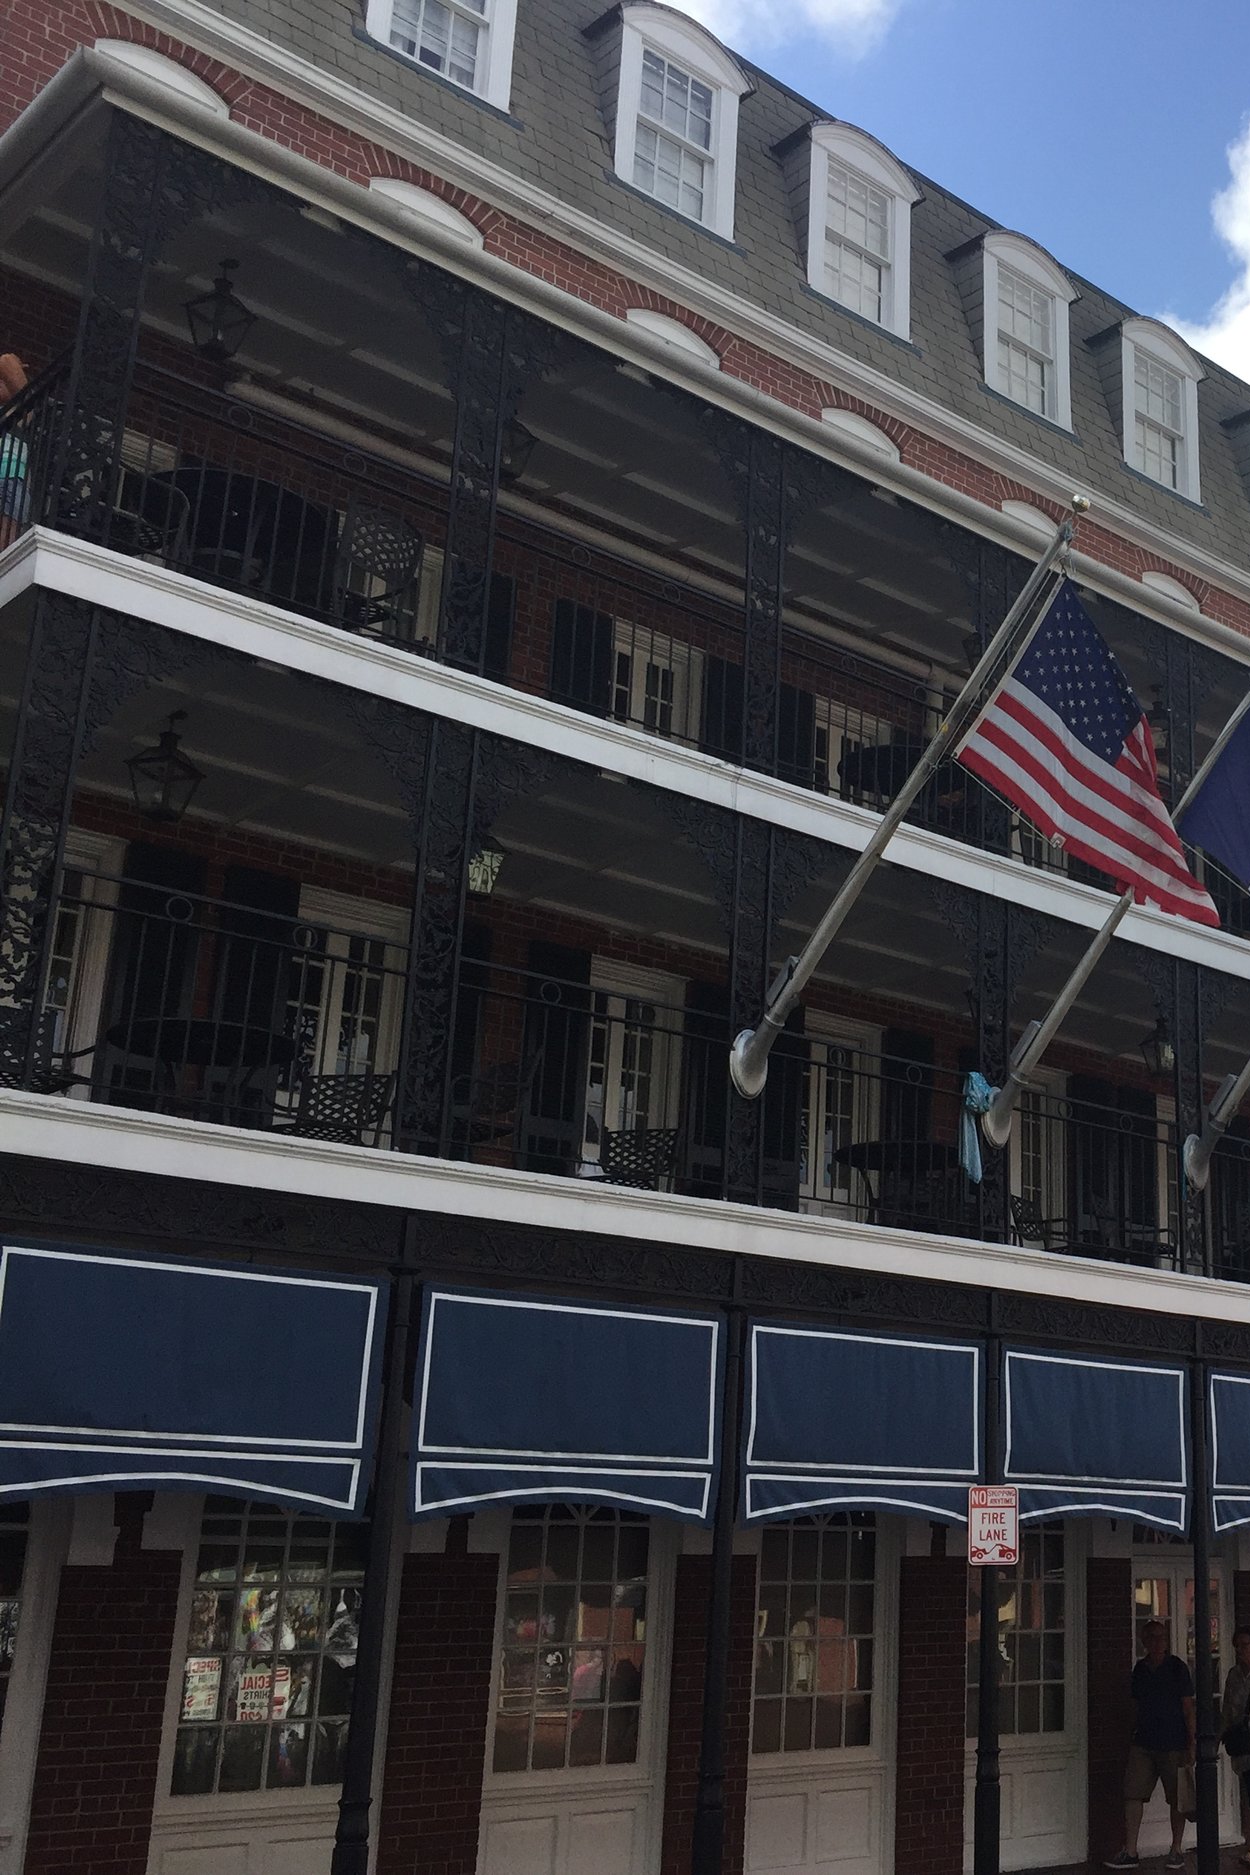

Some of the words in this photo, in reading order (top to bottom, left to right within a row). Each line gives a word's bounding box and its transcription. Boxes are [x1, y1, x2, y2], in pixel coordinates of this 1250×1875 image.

[971, 1490, 987, 1505] NO
[981, 1512, 1006, 1525] FIRE
[979, 1529, 1008, 1541] LANE
